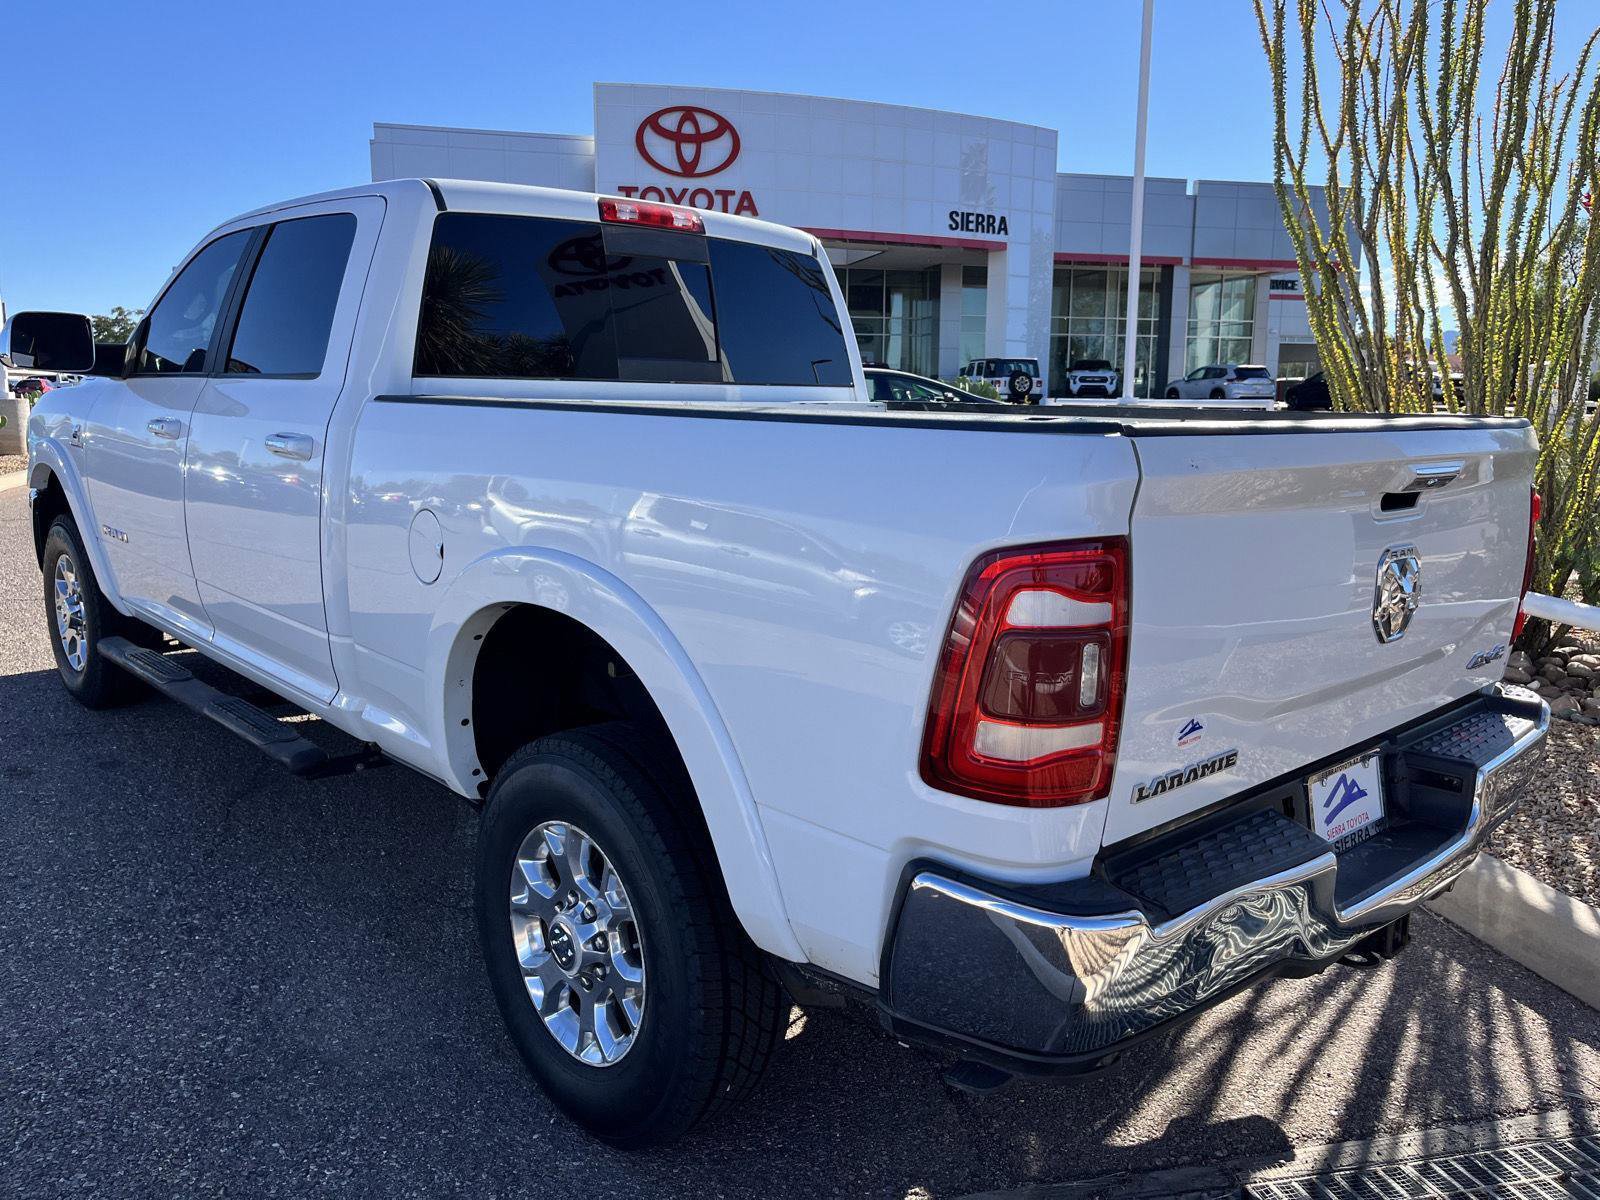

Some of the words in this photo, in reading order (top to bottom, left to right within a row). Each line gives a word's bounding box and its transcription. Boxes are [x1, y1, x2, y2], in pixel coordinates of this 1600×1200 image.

[948, 210, 1009, 236] SIERRA
[1390, 547, 1414, 559] RAM
[1131, 749, 1239, 804] LARAMIE
[1326, 822, 1346, 841] SIERRA
[1346, 811, 1370, 830] TOYOTA
[1334, 825, 1371, 854] SIERRA
